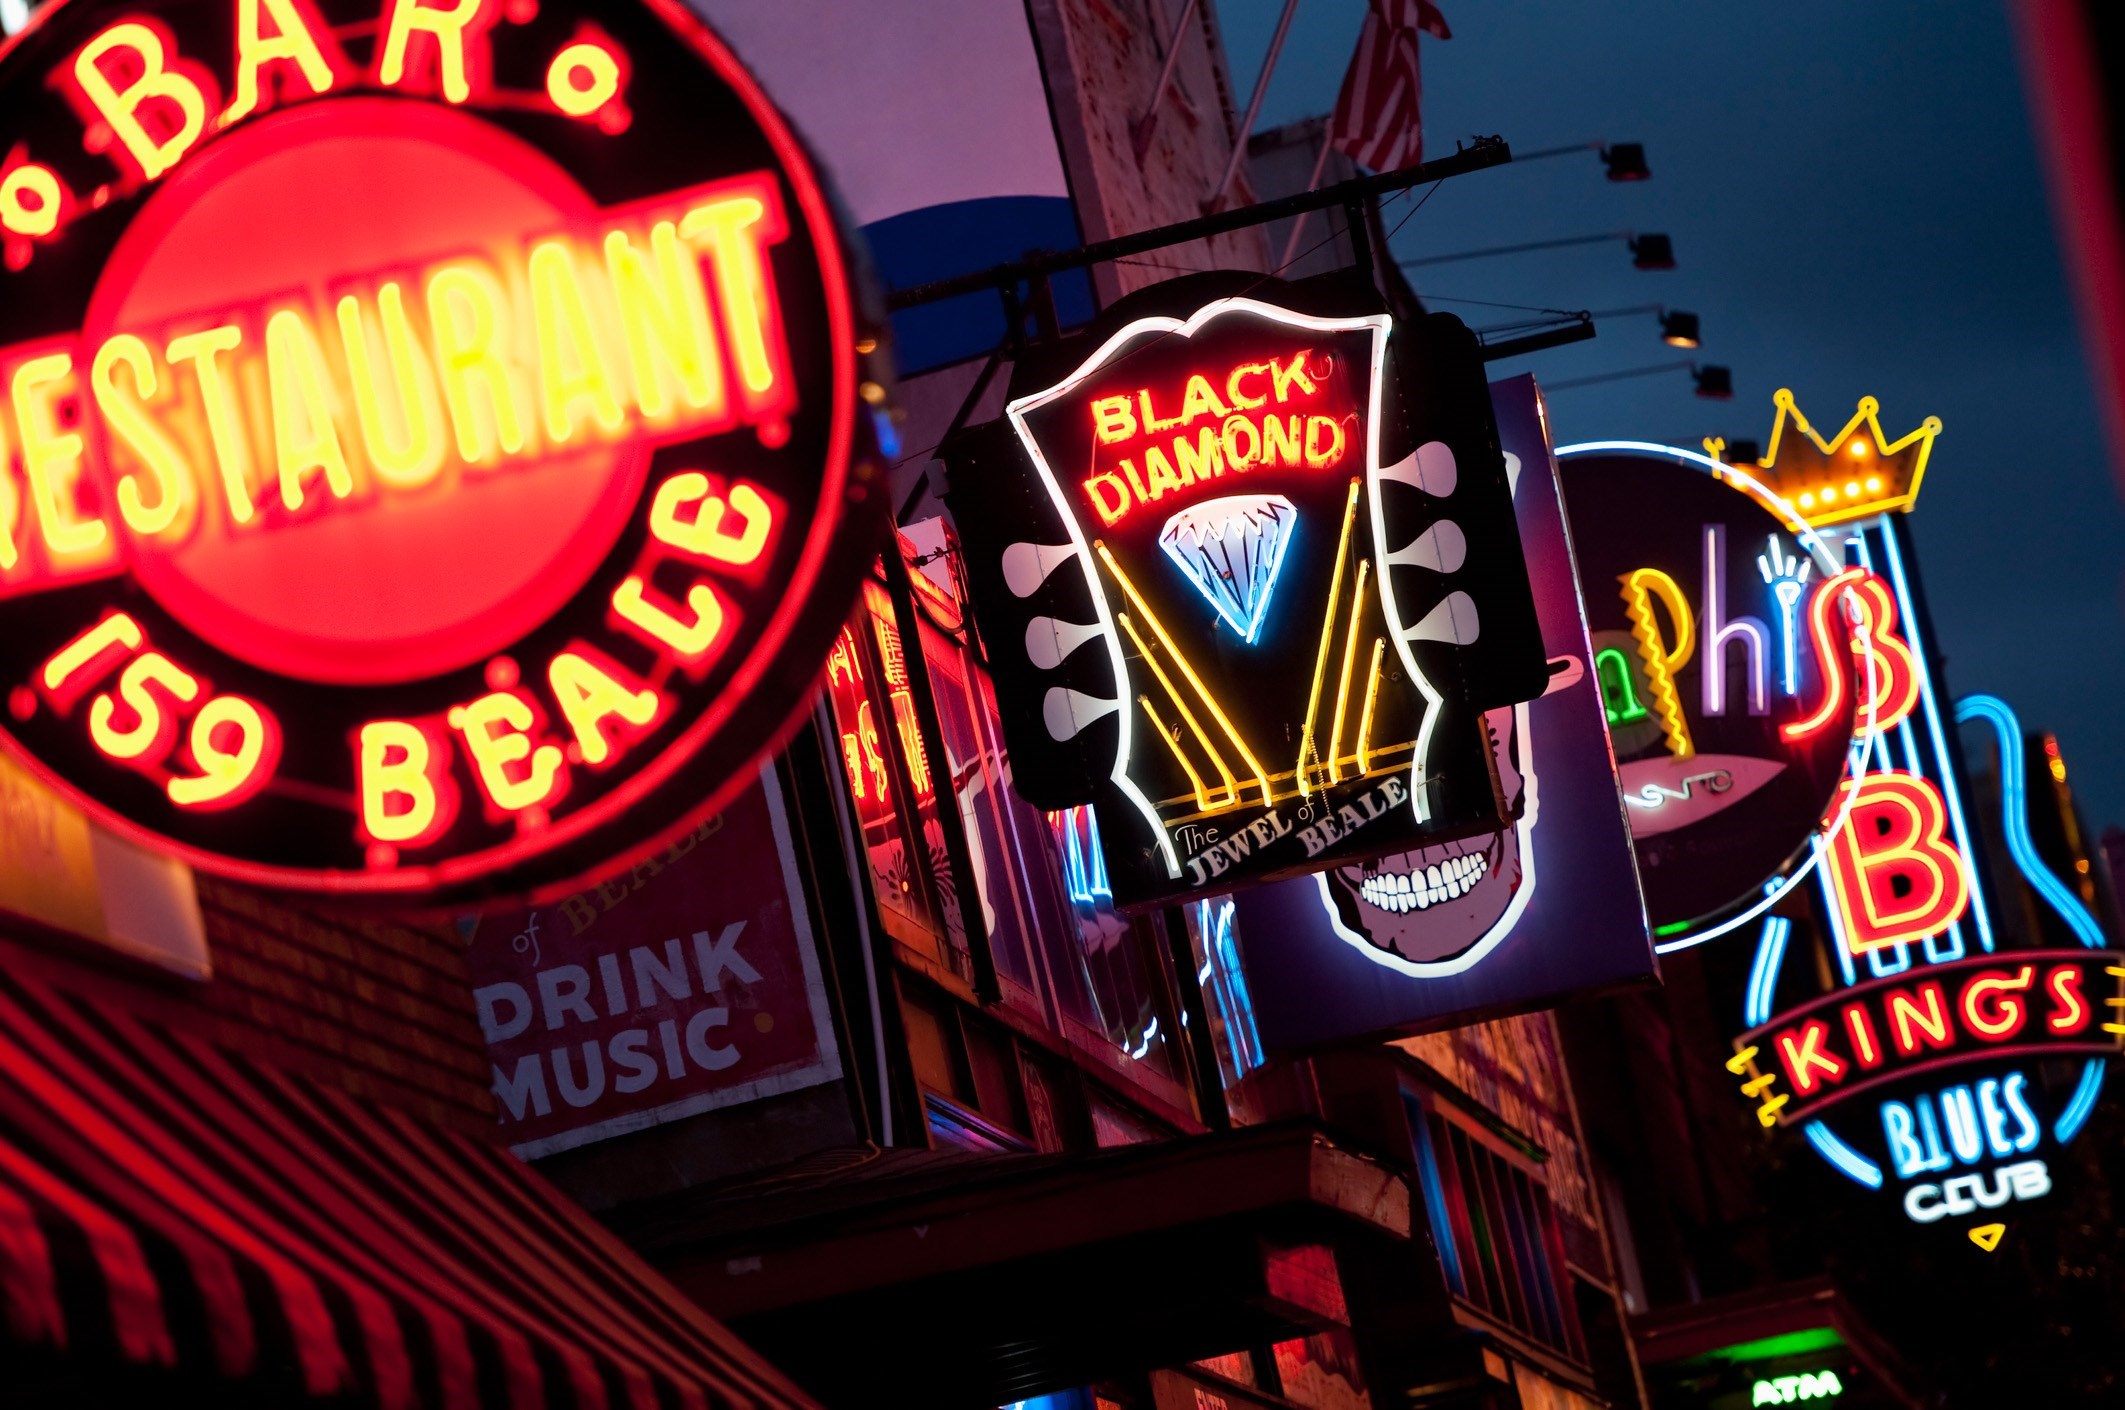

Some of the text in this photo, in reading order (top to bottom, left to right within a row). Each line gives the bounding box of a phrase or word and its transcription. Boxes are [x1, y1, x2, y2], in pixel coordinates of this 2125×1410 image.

[73, 0, 490, 180] BAR
[0, 197, 772, 570] ESTAURANT
[1090, 349, 1319, 446] BLACK
[1083, 414, 1346, 527] DIAMOND
[43, 611, 268, 806] 159
[360, 471, 775, 842] BEALE
[1175, 824, 1220, 855] The
[1187, 794, 1315, 887] JEWEL of
[1296, 776, 1408, 858] BEALE
[473, 920, 764, 1046] DRINK
[512, 912, 541, 967] of
[491, 1007, 742, 1126] MUSIC
[1775, 963, 2091, 1096] KING'S
[1881, 1072, 2040, 1179] BLUES
[1904, 1160, 2052, 1223] CLUB
[1752, 1370, 1842, 1407] ATM
